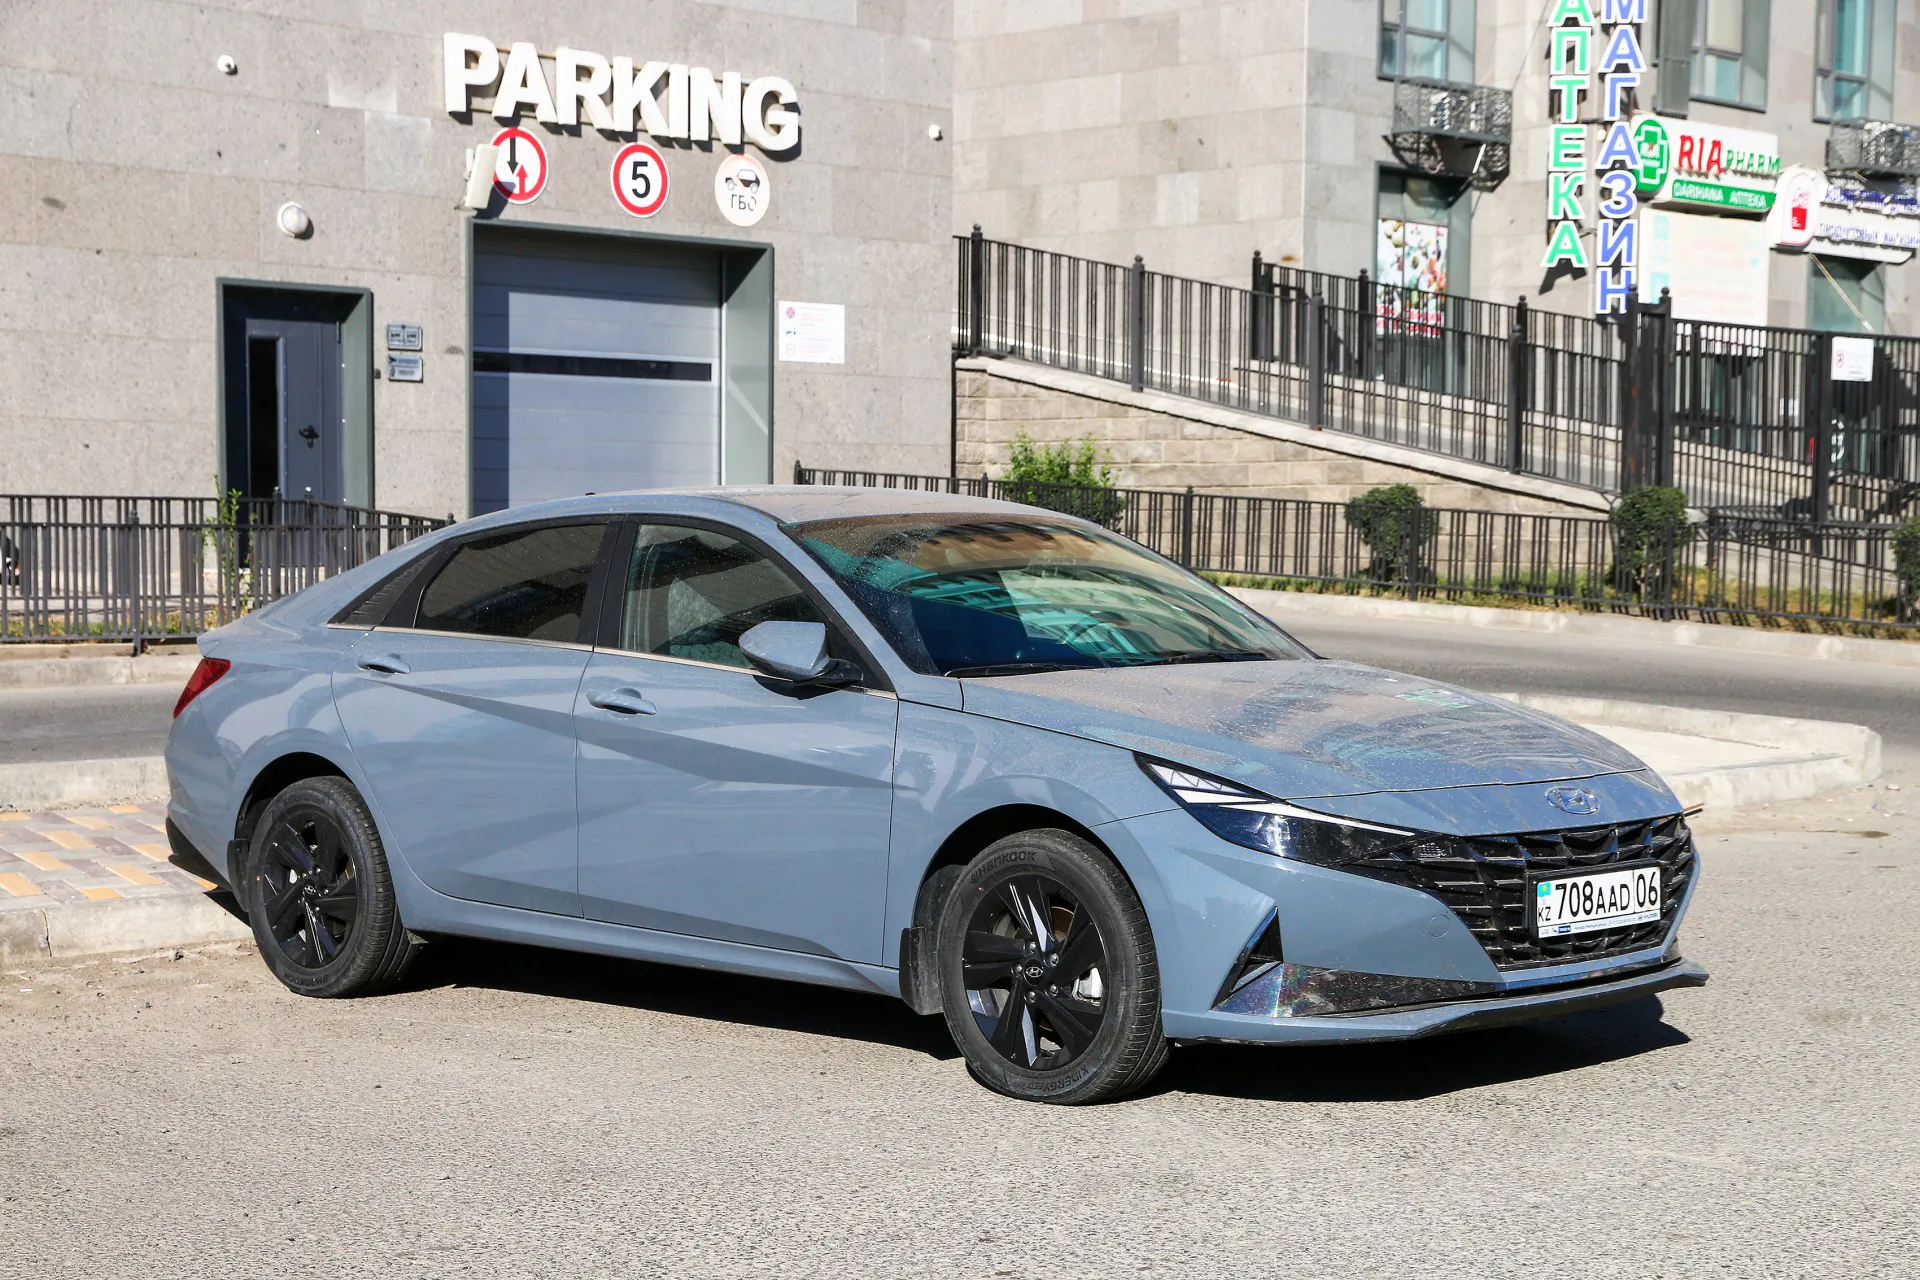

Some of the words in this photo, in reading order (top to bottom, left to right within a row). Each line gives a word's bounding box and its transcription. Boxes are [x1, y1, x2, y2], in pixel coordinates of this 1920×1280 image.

[444, 32, 800, 151] PARKING
[1541, 0, 1595, 267] АПТЕКА
[1678, 134, 1723, 174] RIA
[1726, 149, 1781, 175] PHARM
[631, 161, 652, 199] 5
[730, 193, 757, 212] ГБО
[1538, 906, 1551, 922] KZ
[1555, 880, 1630, 920] 708AAD
[1636, 871, 1658, 908] 06
